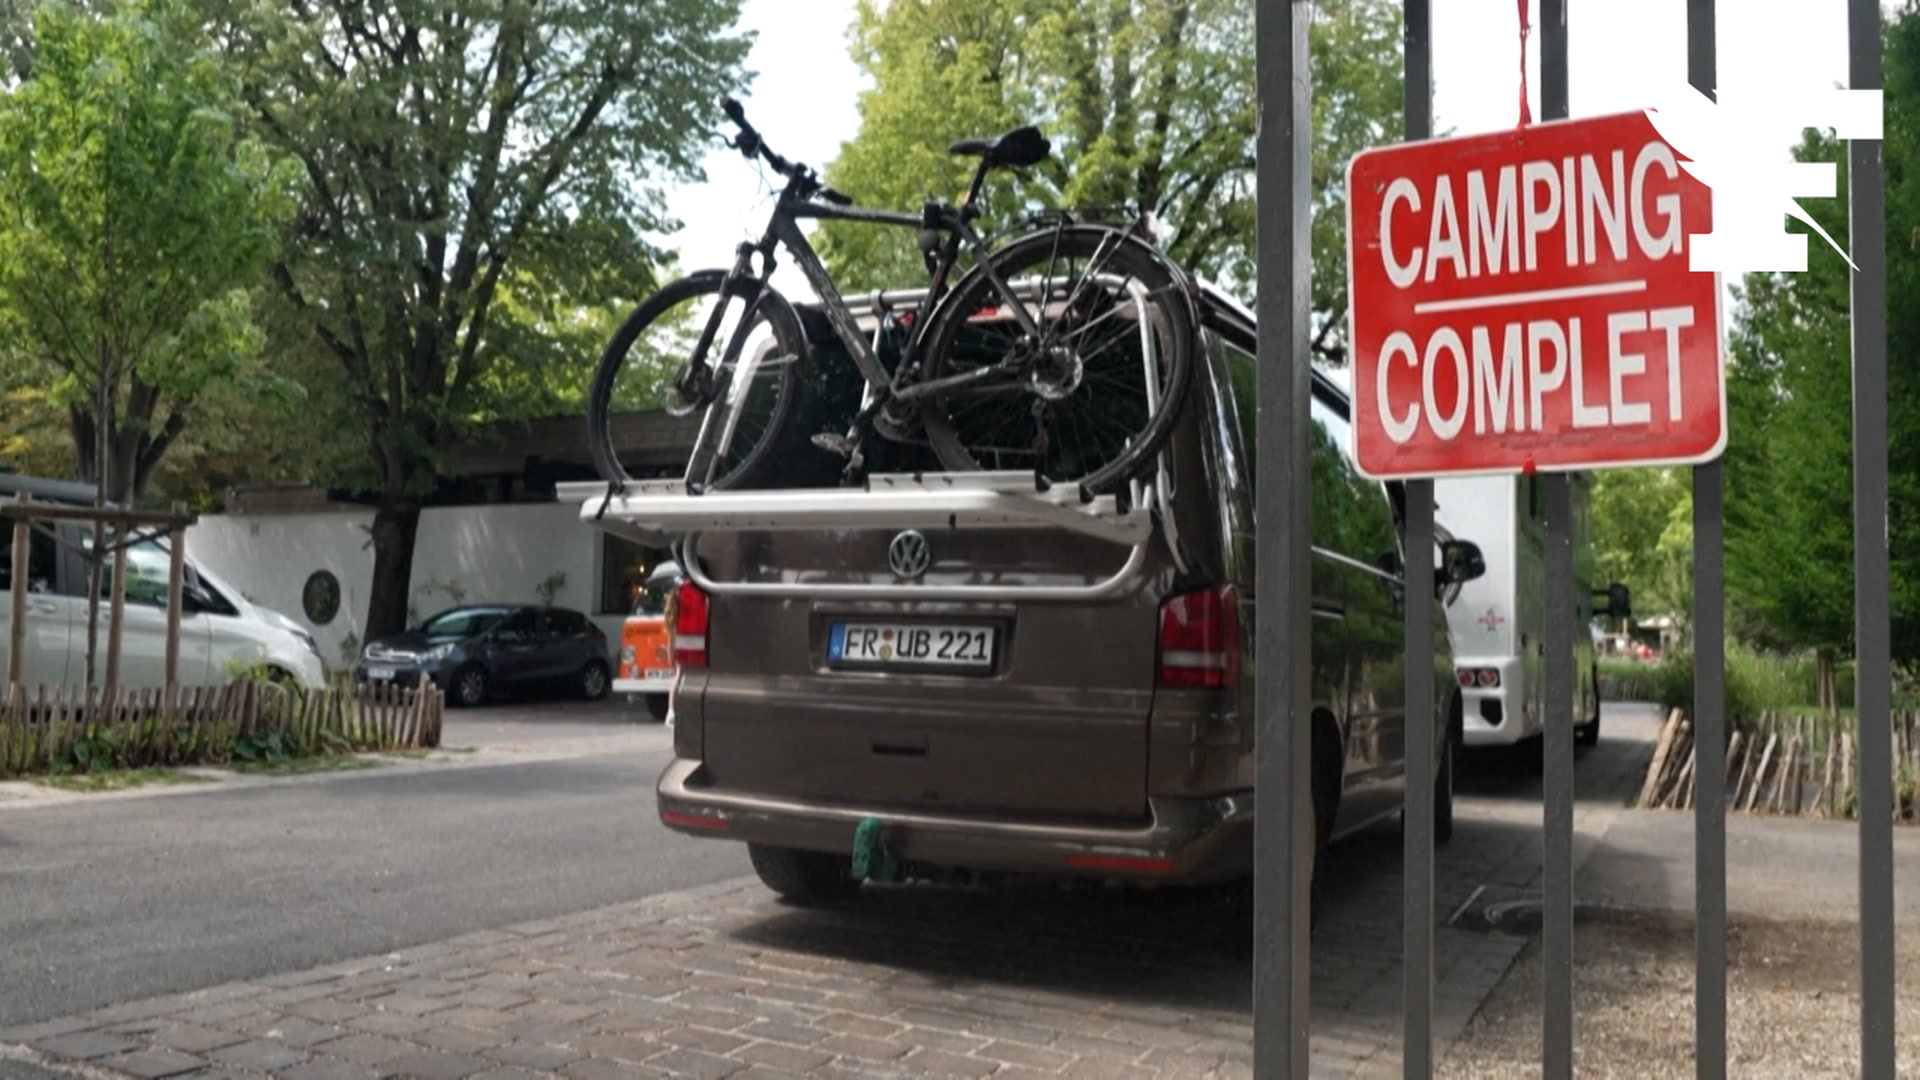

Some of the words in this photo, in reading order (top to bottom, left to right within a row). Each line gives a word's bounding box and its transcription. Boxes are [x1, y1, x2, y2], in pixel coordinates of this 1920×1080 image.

[1380, 141, 1683, 288] CAMPING
[1376, 306, 1695, 443] COMPLET
[845, 628, 878, 656] FR
[896, 630, 931, 658] UB
[936, 631, 988, 660] 221
